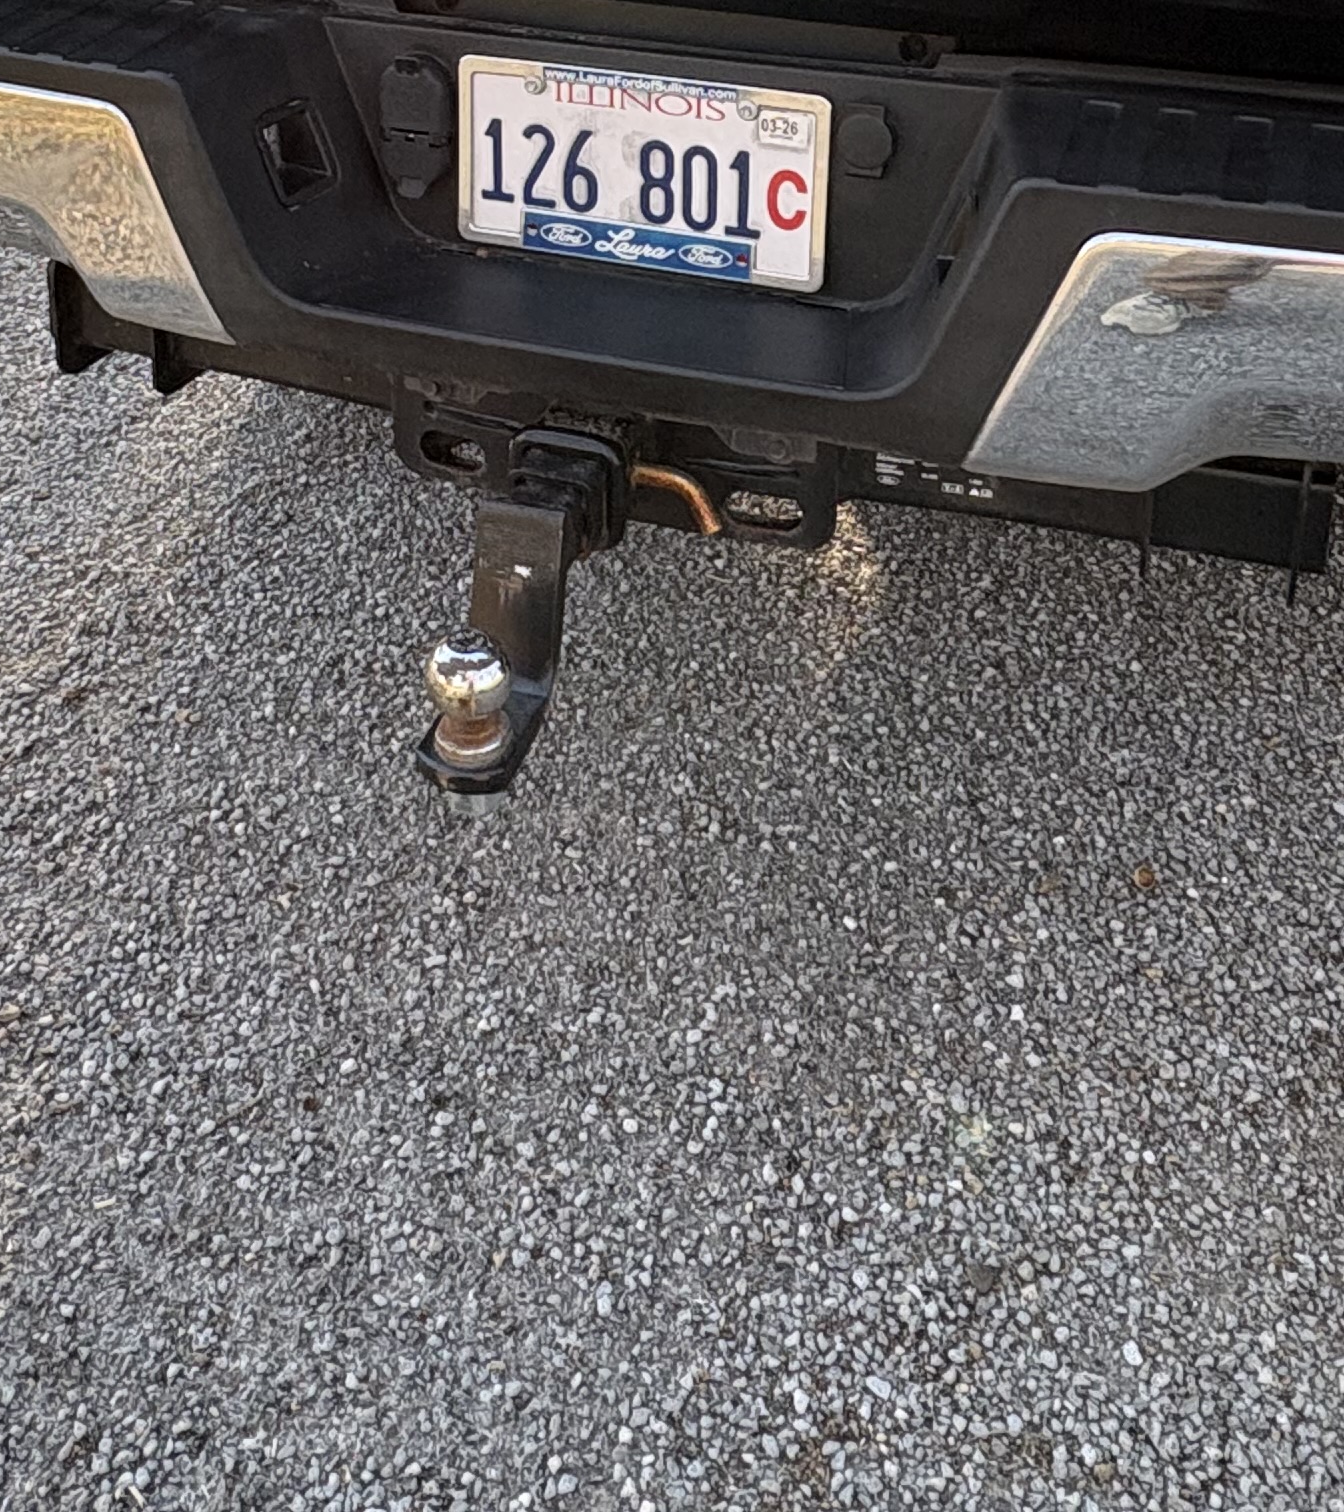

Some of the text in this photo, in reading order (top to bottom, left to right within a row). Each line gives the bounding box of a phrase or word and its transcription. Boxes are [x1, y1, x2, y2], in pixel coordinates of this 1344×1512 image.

[544, 68, 737, 102] www.LauraFordofSullivan.com
[555, 80, 726, 122] ILLINOIS
[761, 118, 799, 136] 03-26
[481, 118, 809, 240] 126 801 C
[548, 225, 723, 266] Ford Laura Ford
